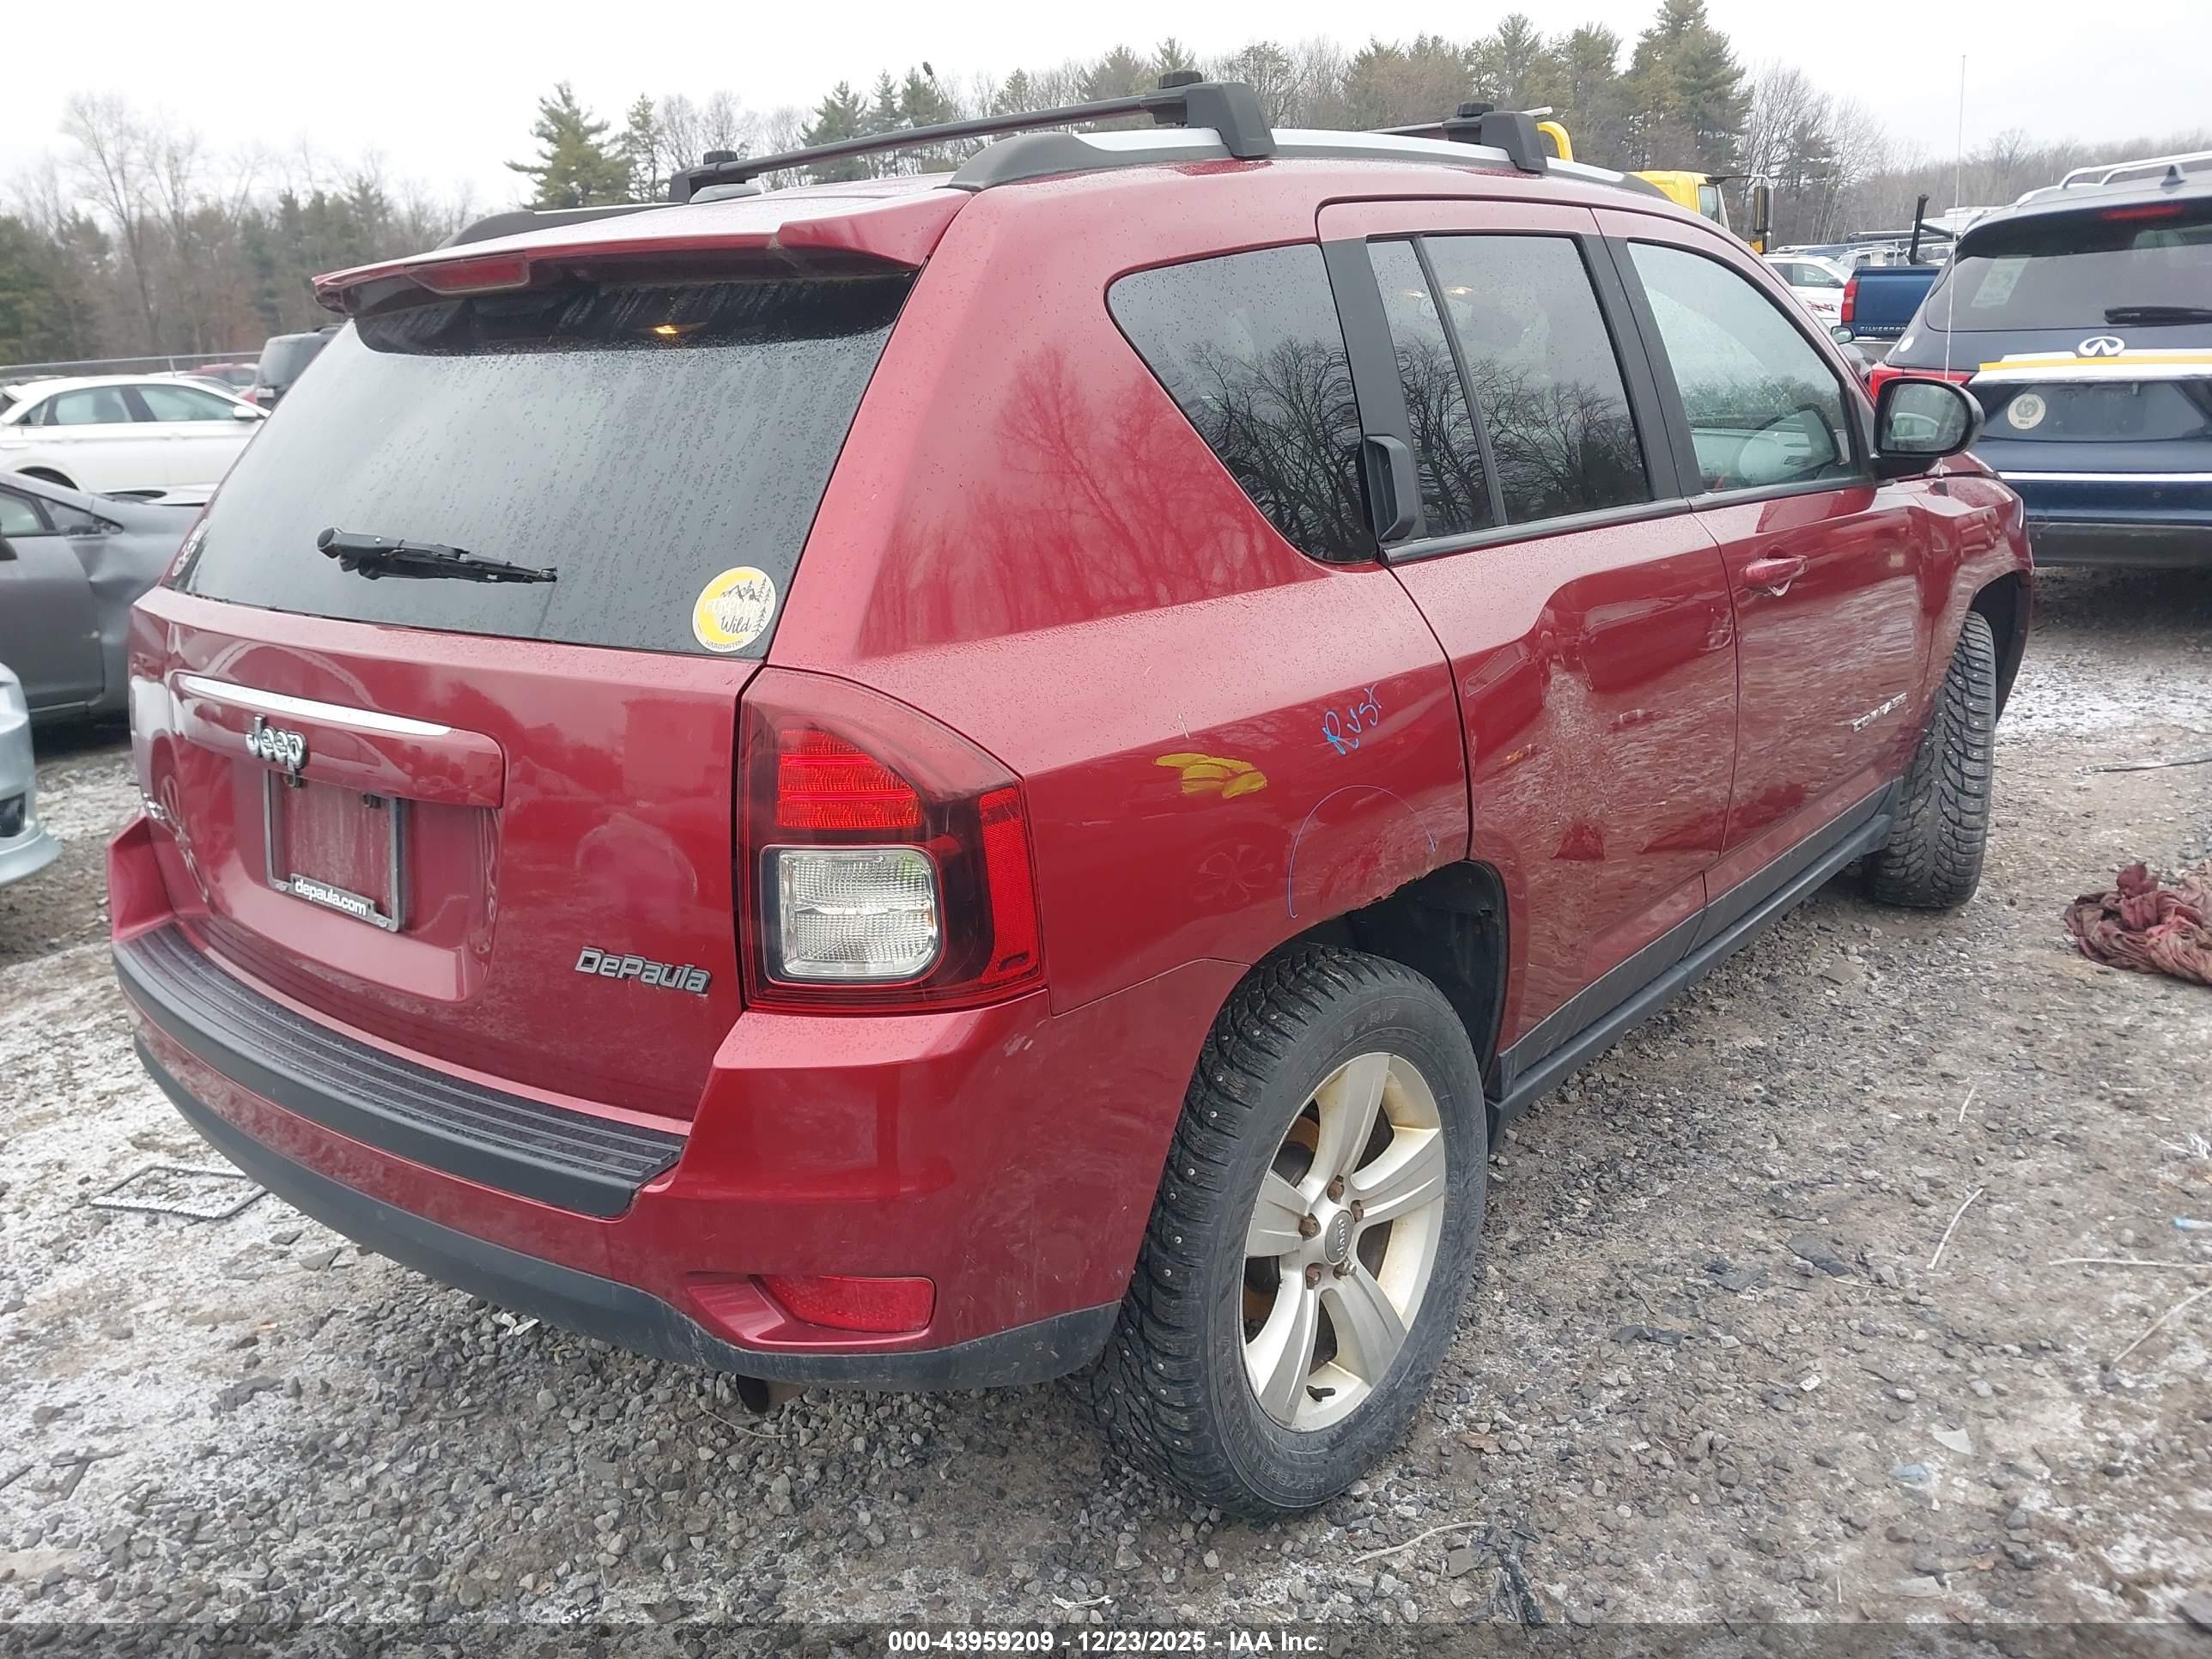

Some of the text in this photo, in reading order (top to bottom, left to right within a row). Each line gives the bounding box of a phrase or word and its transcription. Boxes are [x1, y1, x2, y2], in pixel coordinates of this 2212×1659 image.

[720, 615, 752, 634] Wild
[245, 714, 307, 774] Jeep
[295, 878, 367, 916] depaula.com
[574, 946, 712, 994] DePaula
